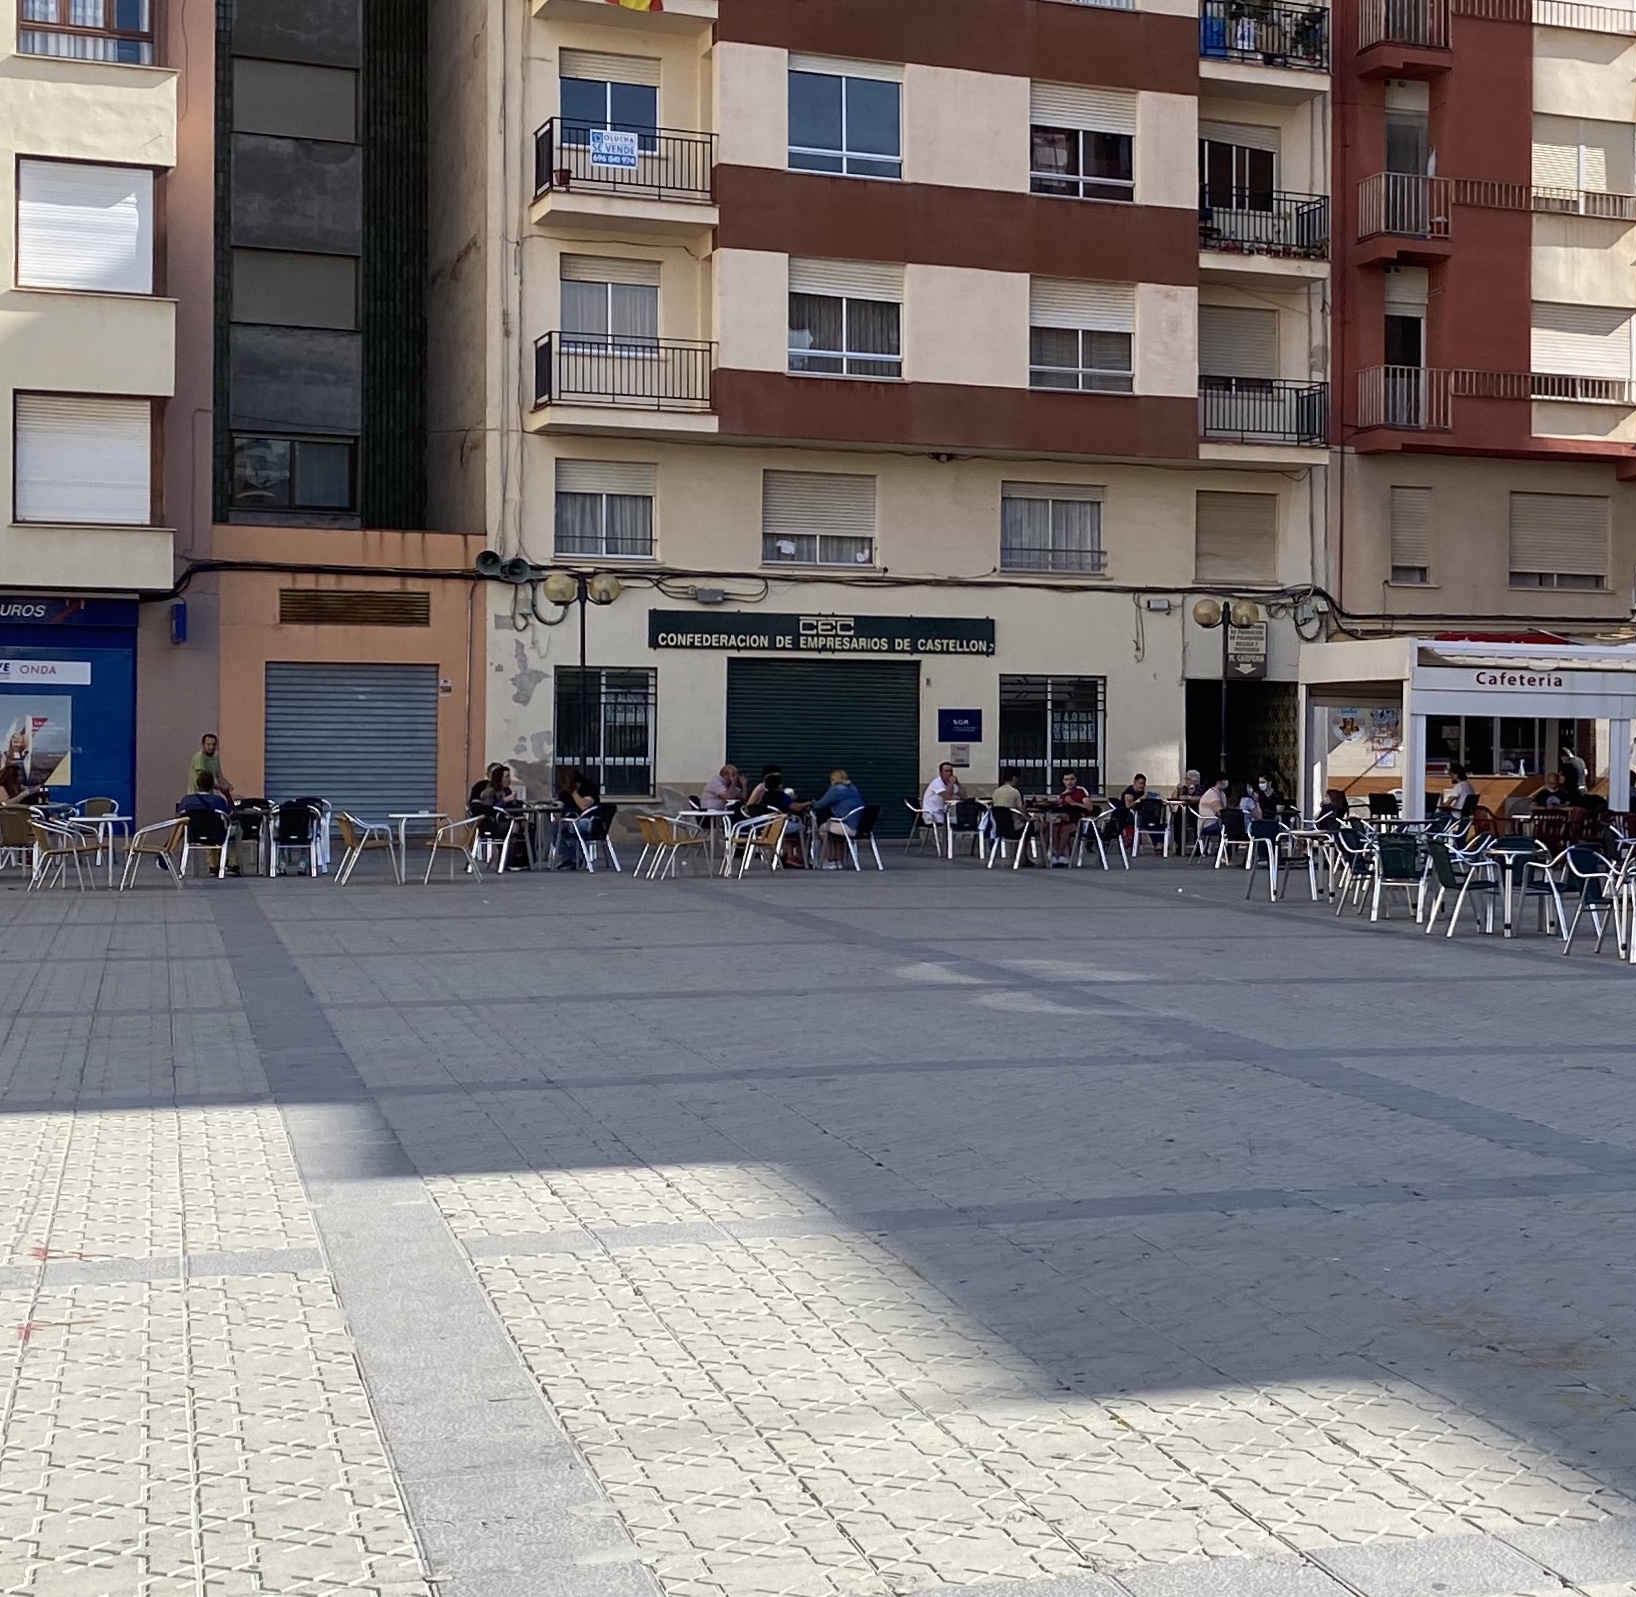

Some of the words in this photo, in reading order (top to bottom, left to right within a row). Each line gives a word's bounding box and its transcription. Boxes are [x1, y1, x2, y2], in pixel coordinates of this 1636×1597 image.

[592, 143, 602, 152] SE
[605, 144, 634, 155] VENDE
[593, 154, 606, 162] 696
[0, 604, 46, 617] UROS
[799, 617, 854, 635] CEC
[658, 633, 768, 648] CONFEDERACION
[776, 636, 793, 648] DE
[799, 637, 888, 651] EMPRESARIOS
[895, 639, 911, 651] DE
[918, 639, 986, 652] CASTELLON
[19, 665, 57, 675] ONDA
[1476, 671, 1563, 688] Cafeteria
